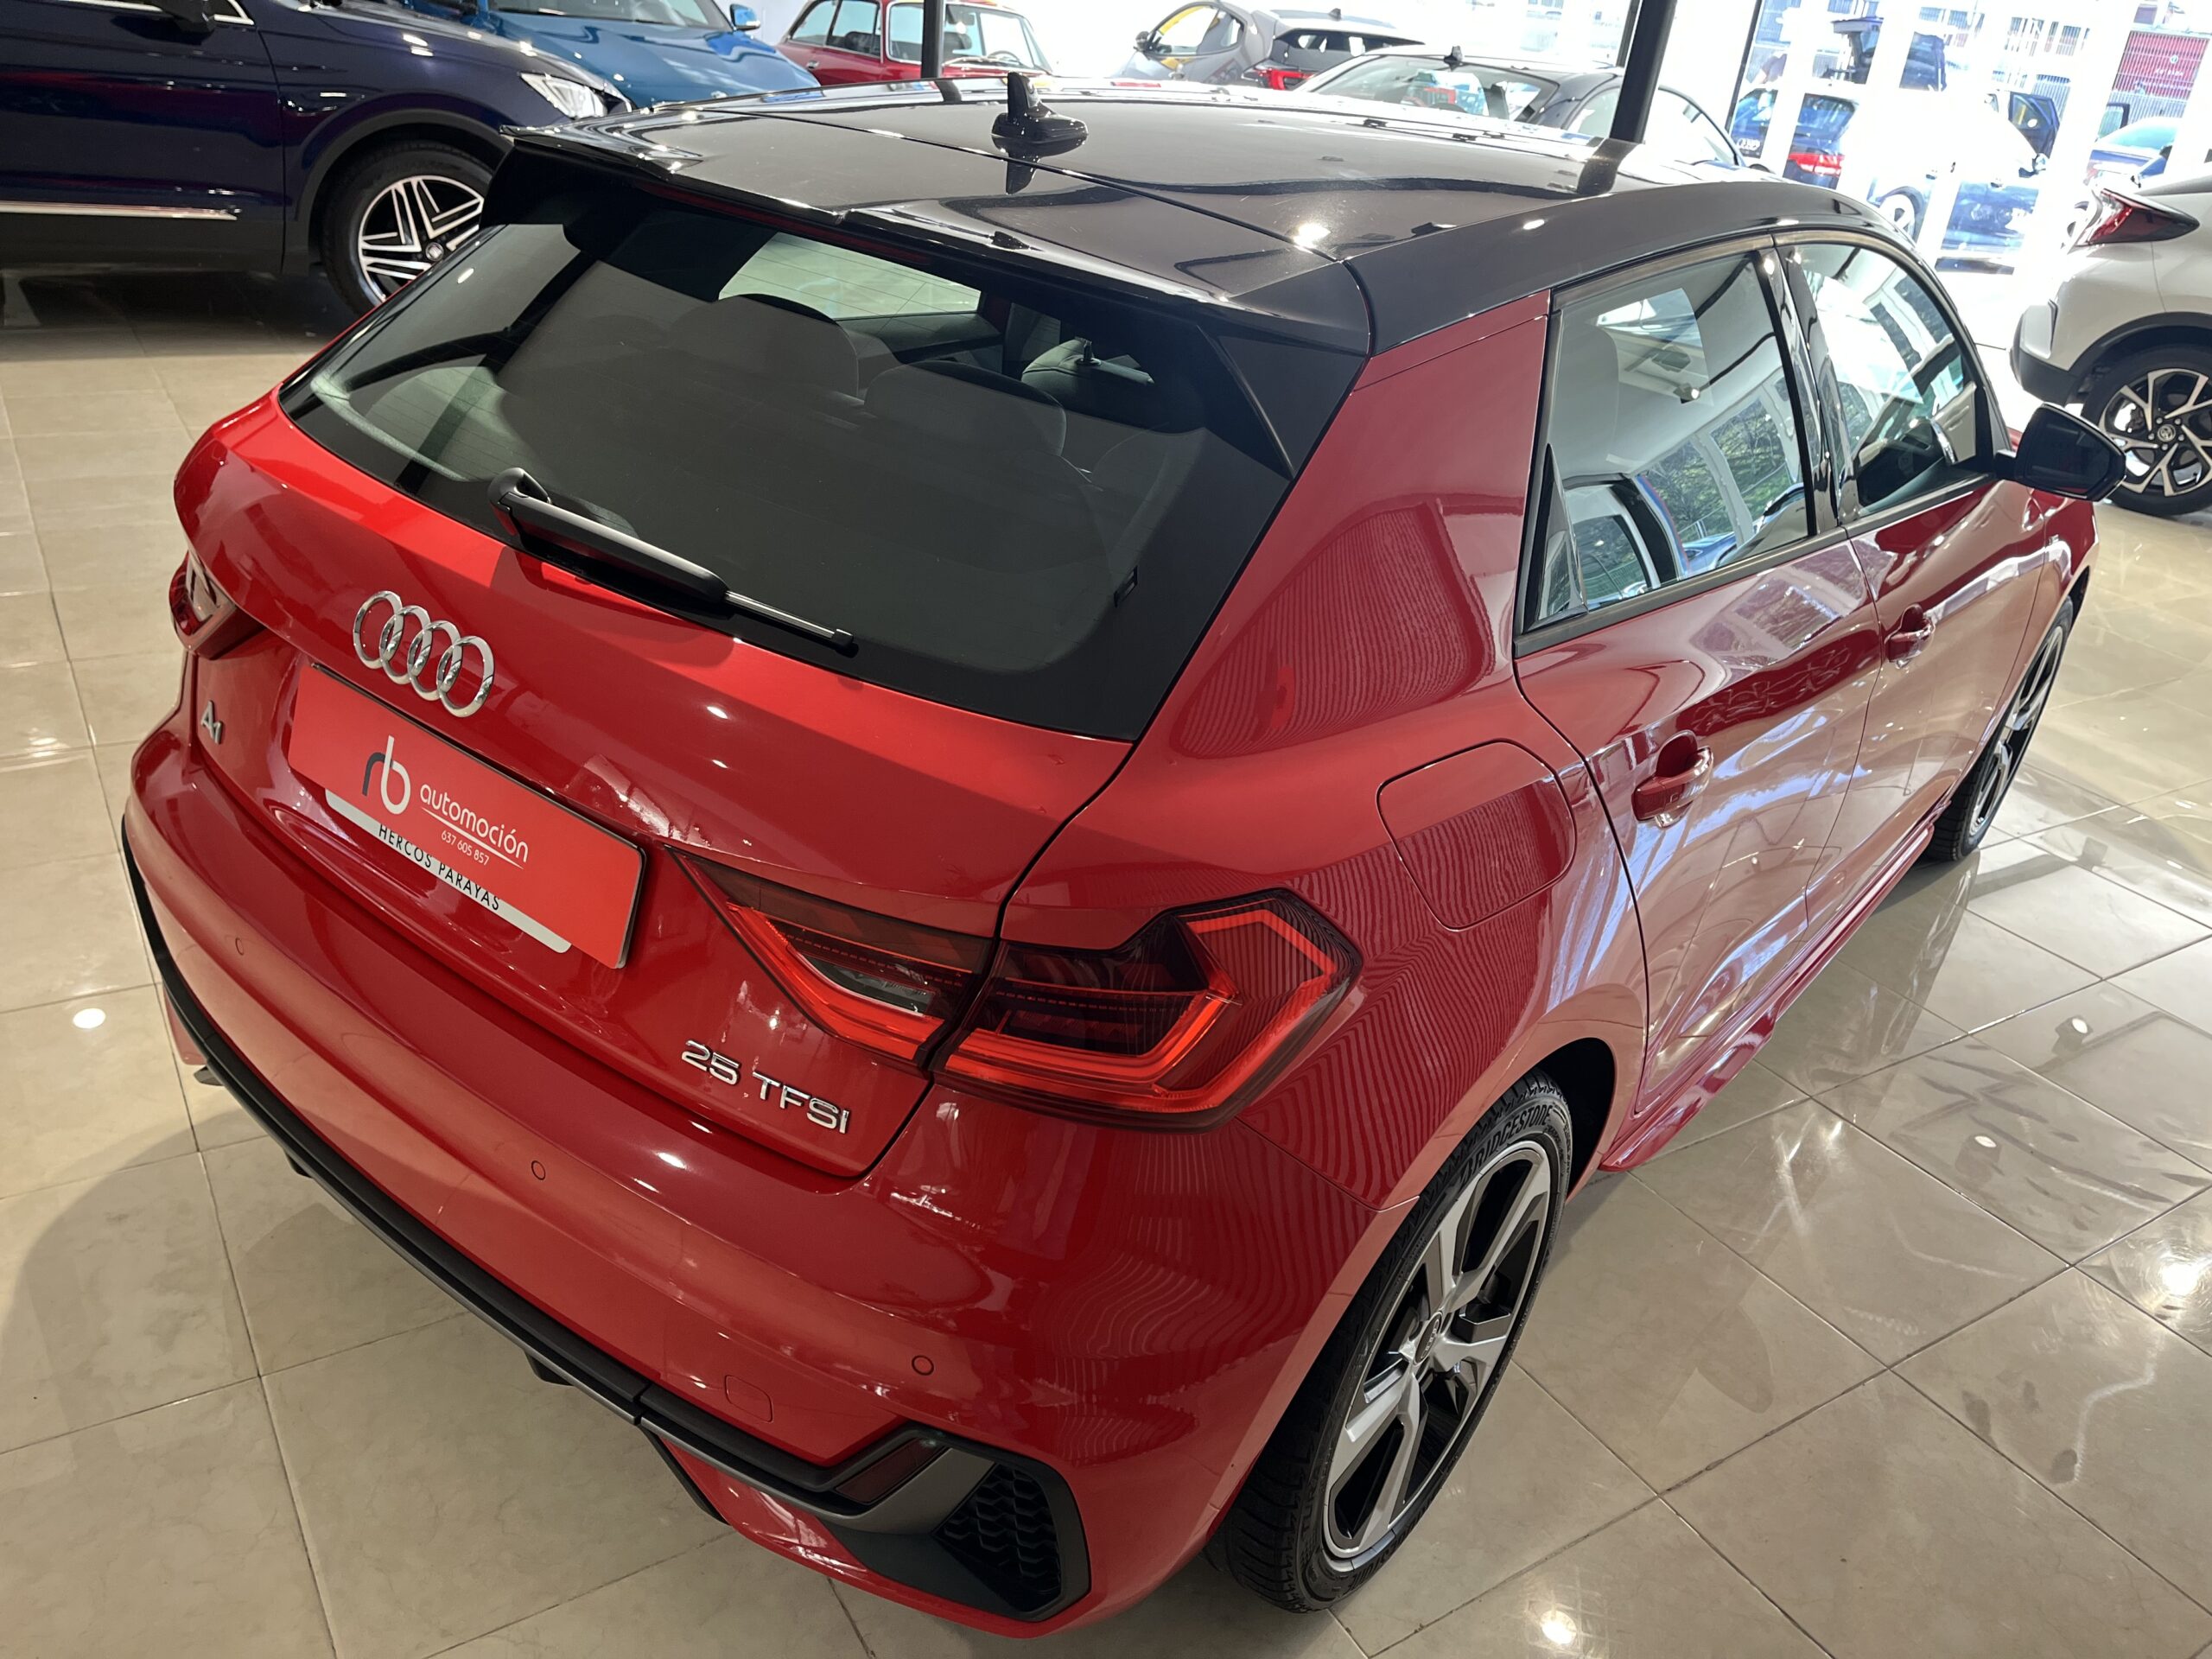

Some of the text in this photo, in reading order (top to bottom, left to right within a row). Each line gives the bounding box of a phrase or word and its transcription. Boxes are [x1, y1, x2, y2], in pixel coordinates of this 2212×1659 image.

[200, 700, 222, 745] A1
[361, 734, 529, 862] rb automoción
[378, 823, 499, 911] HERCOS PARAYAS
[441, 830, 490, 866] 637 605 857
[681, 1039, 850, 1134] 25 TFSI
[1459, 1103, 1554, 1186] BRIDGESTONE
